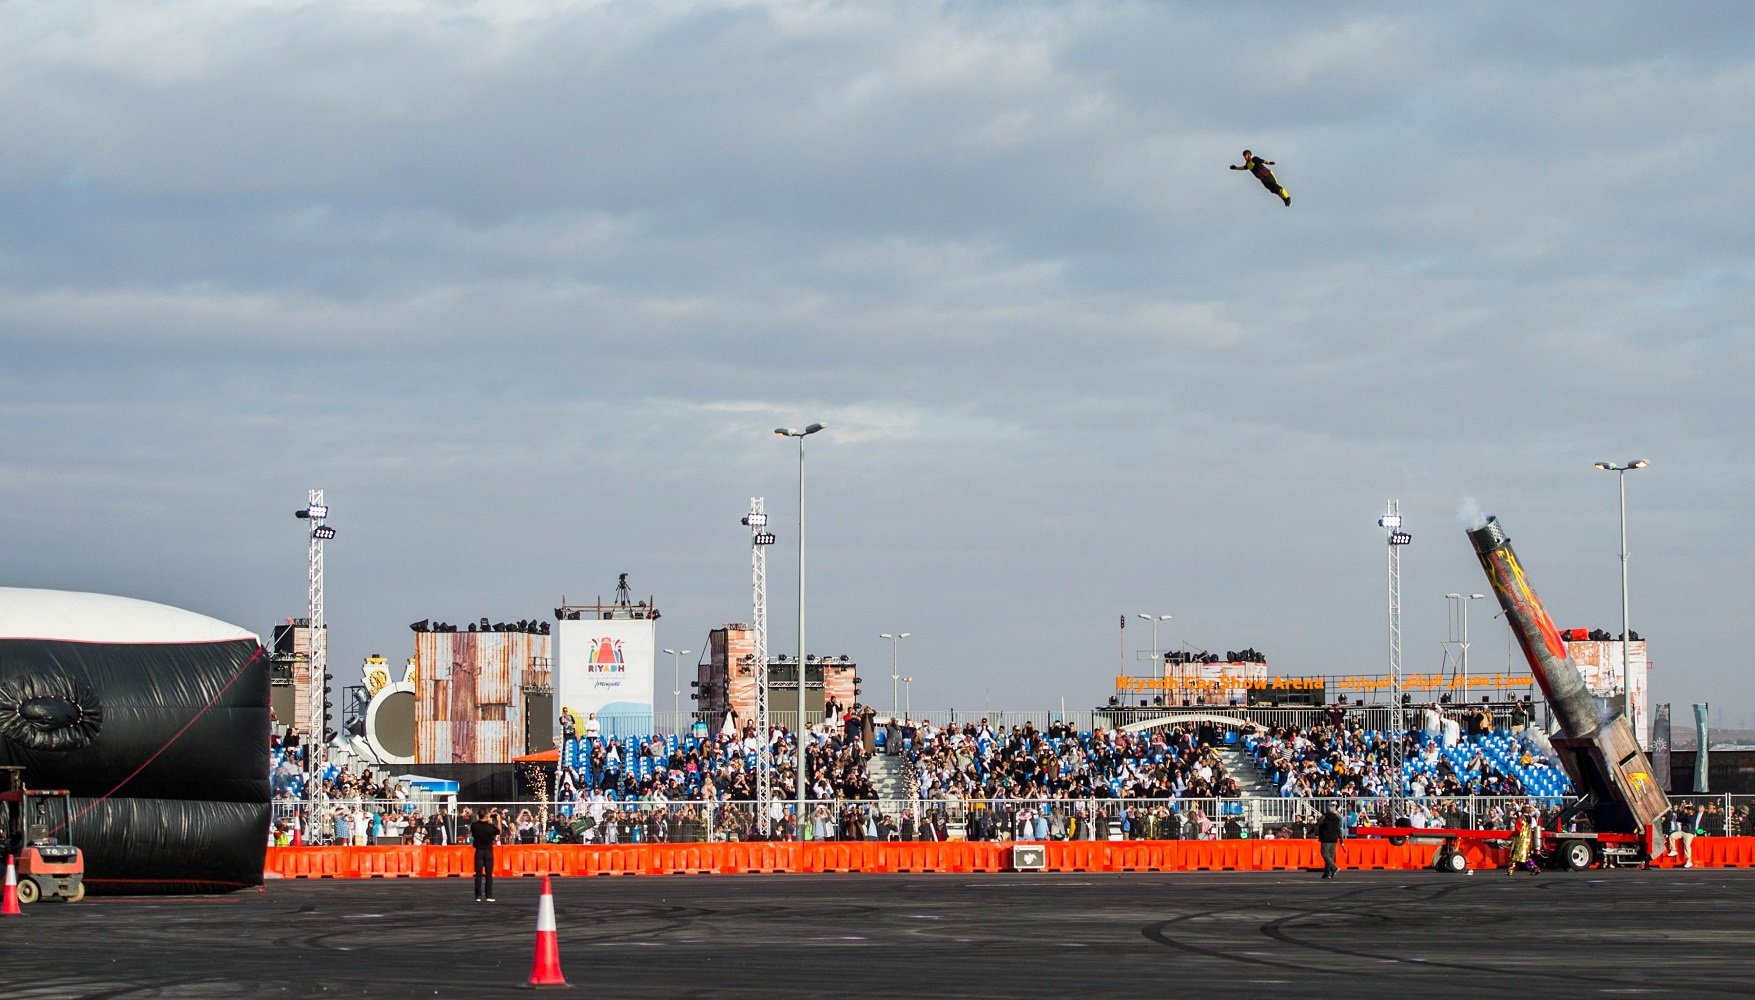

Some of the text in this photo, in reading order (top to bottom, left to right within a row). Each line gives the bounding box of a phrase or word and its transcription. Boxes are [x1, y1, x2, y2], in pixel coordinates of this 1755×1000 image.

[588, 664, 625, 673] RIYADH
[1116, 674, 1325, 692] Riyadh Car Show Arena
[1446, 672, 1490, 689] معرض
